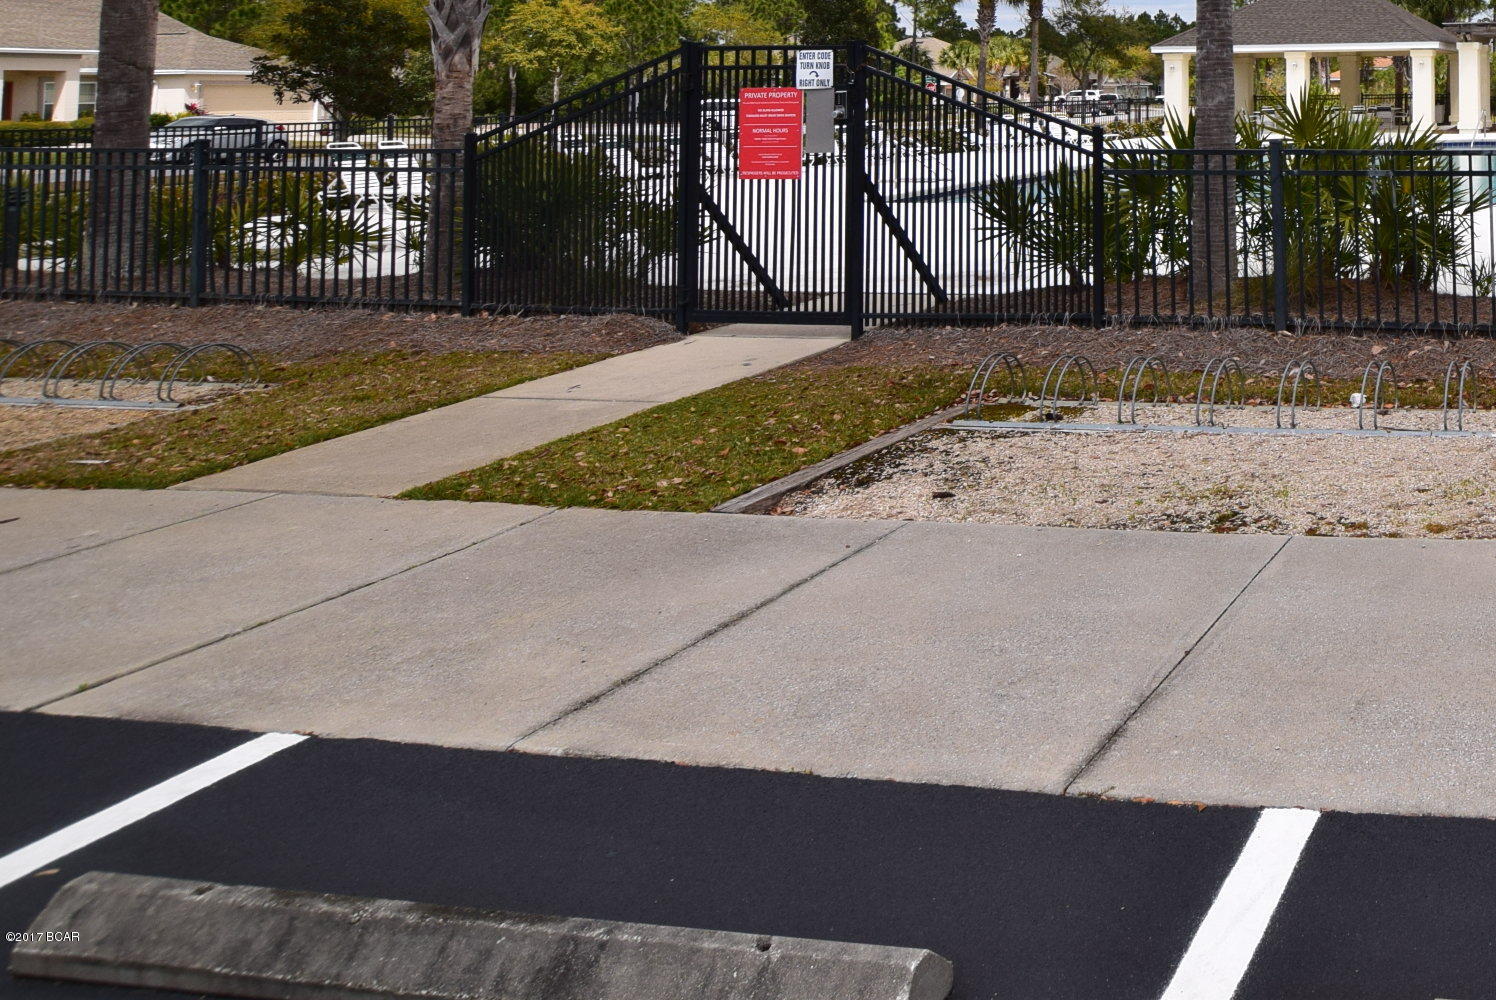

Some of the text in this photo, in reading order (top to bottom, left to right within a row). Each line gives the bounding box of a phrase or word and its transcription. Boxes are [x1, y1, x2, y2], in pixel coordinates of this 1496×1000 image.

[799, 52, 831, 60] ENTER CODE
[799, 79, 814, 87] RIGHT
